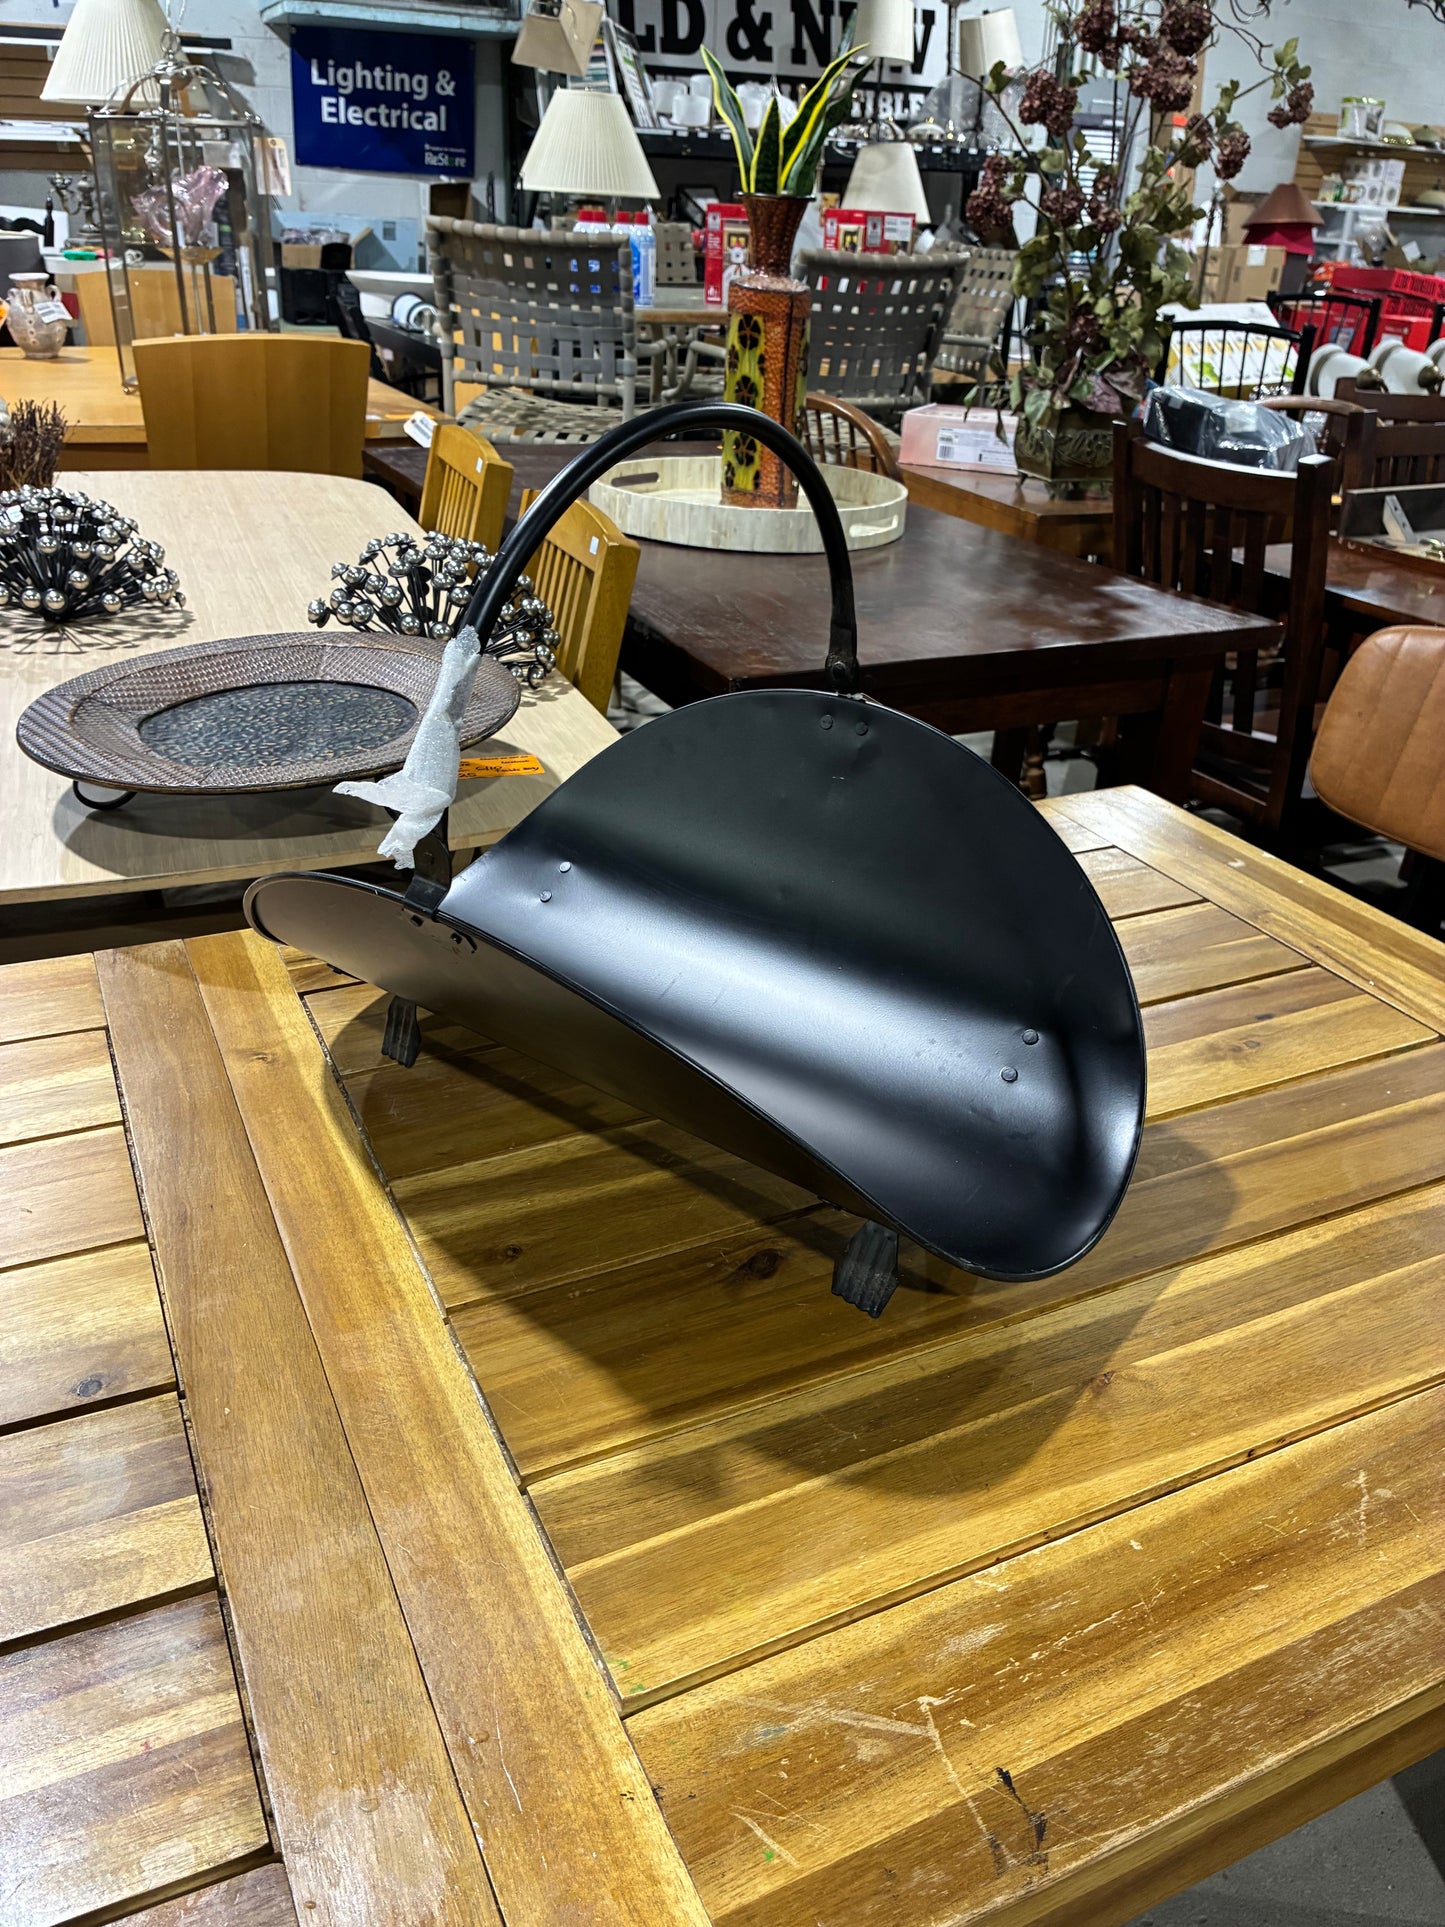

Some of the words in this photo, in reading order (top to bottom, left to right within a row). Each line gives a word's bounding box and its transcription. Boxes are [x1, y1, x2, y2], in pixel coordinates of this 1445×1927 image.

[617, 0, 706, 55] LD
[726, 0, 773, 63] &
[310, 57, 429, 101] Lighting
[434, 69, 457, 97] &
[320, 96, 448, 132] Electrical
